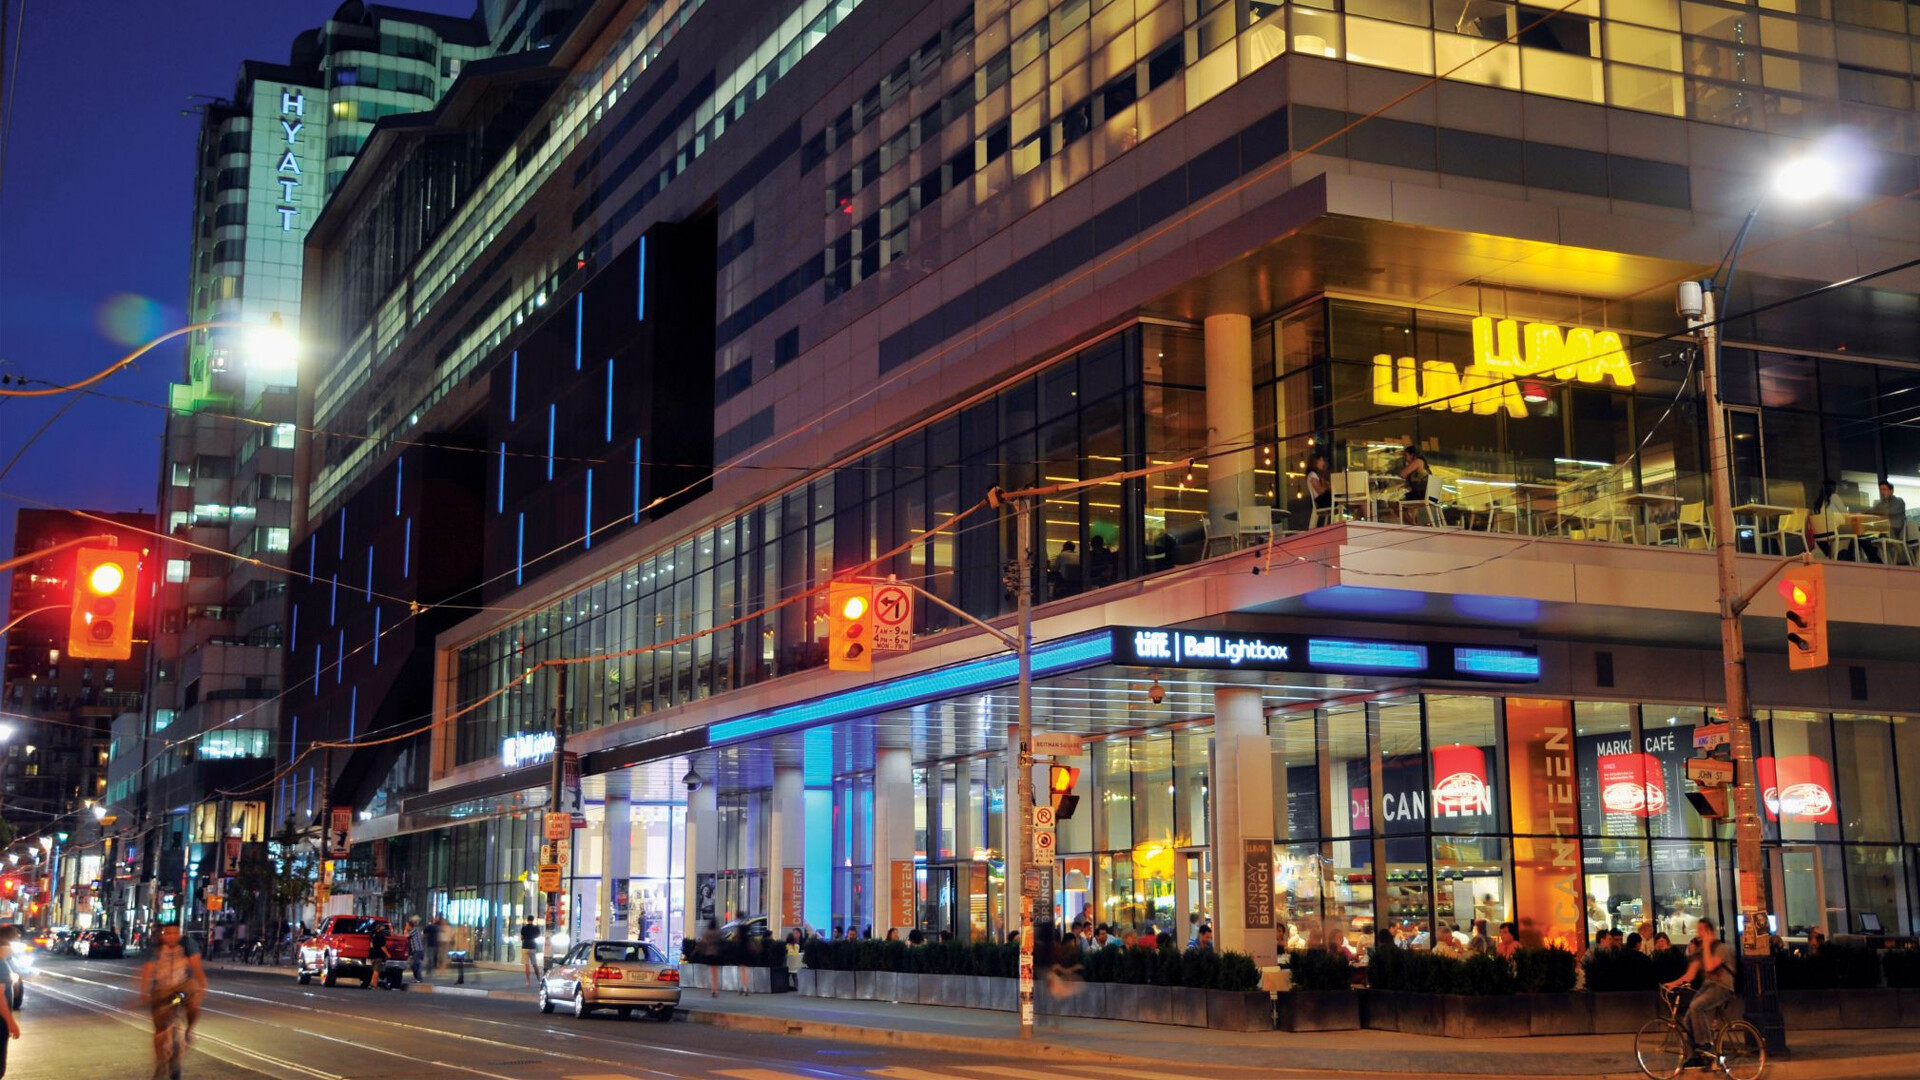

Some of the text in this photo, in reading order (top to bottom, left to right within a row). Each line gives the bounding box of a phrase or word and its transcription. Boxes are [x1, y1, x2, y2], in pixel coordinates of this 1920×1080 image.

[278, 92, 304, 232] HYATT
[1472, 316, 1636, 387] LUMA
[1215, 636, 1289, 664] Lightbox
[1645, 731, 1675, 753] CAFÉ
[1382, 784, 1492, 822] CANTEEN
[1698, 769, 1723, 780] JOHN ST
[1544, 726, 1580, 925] CANTEEN
[792, 868, 803, 925] CANTEEN
[902, 862, 913, 926] CANTEEN
[1041, 870, 1050, 923] BRUNCH
[1247, 863, 1259, 924] SUNDAY
[1258, 862, 1270, 925] BRUNCH
